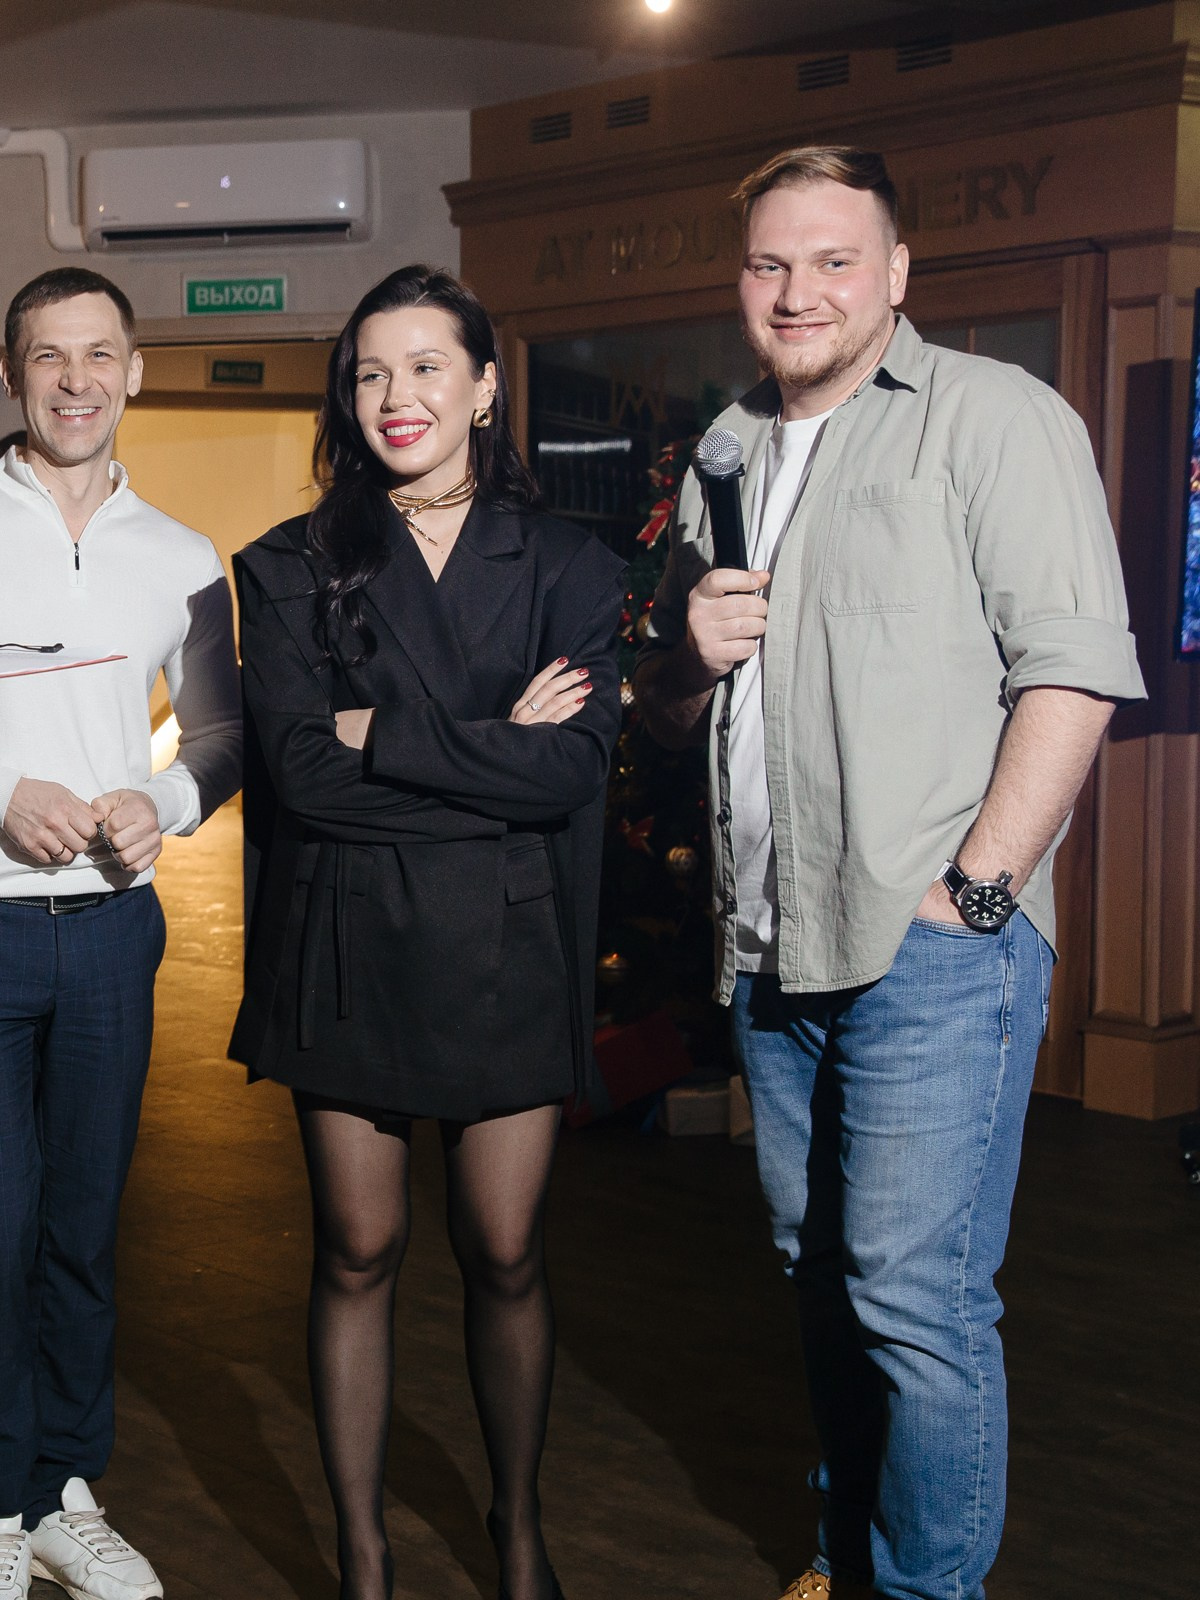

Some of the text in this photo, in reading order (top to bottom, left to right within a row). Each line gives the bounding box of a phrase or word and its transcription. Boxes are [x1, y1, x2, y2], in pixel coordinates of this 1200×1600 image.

[532, 228, 593, 286] AT
[896, 154, 1055, 233] NERY
[194, 284, 277, 307] ВЫХОД
